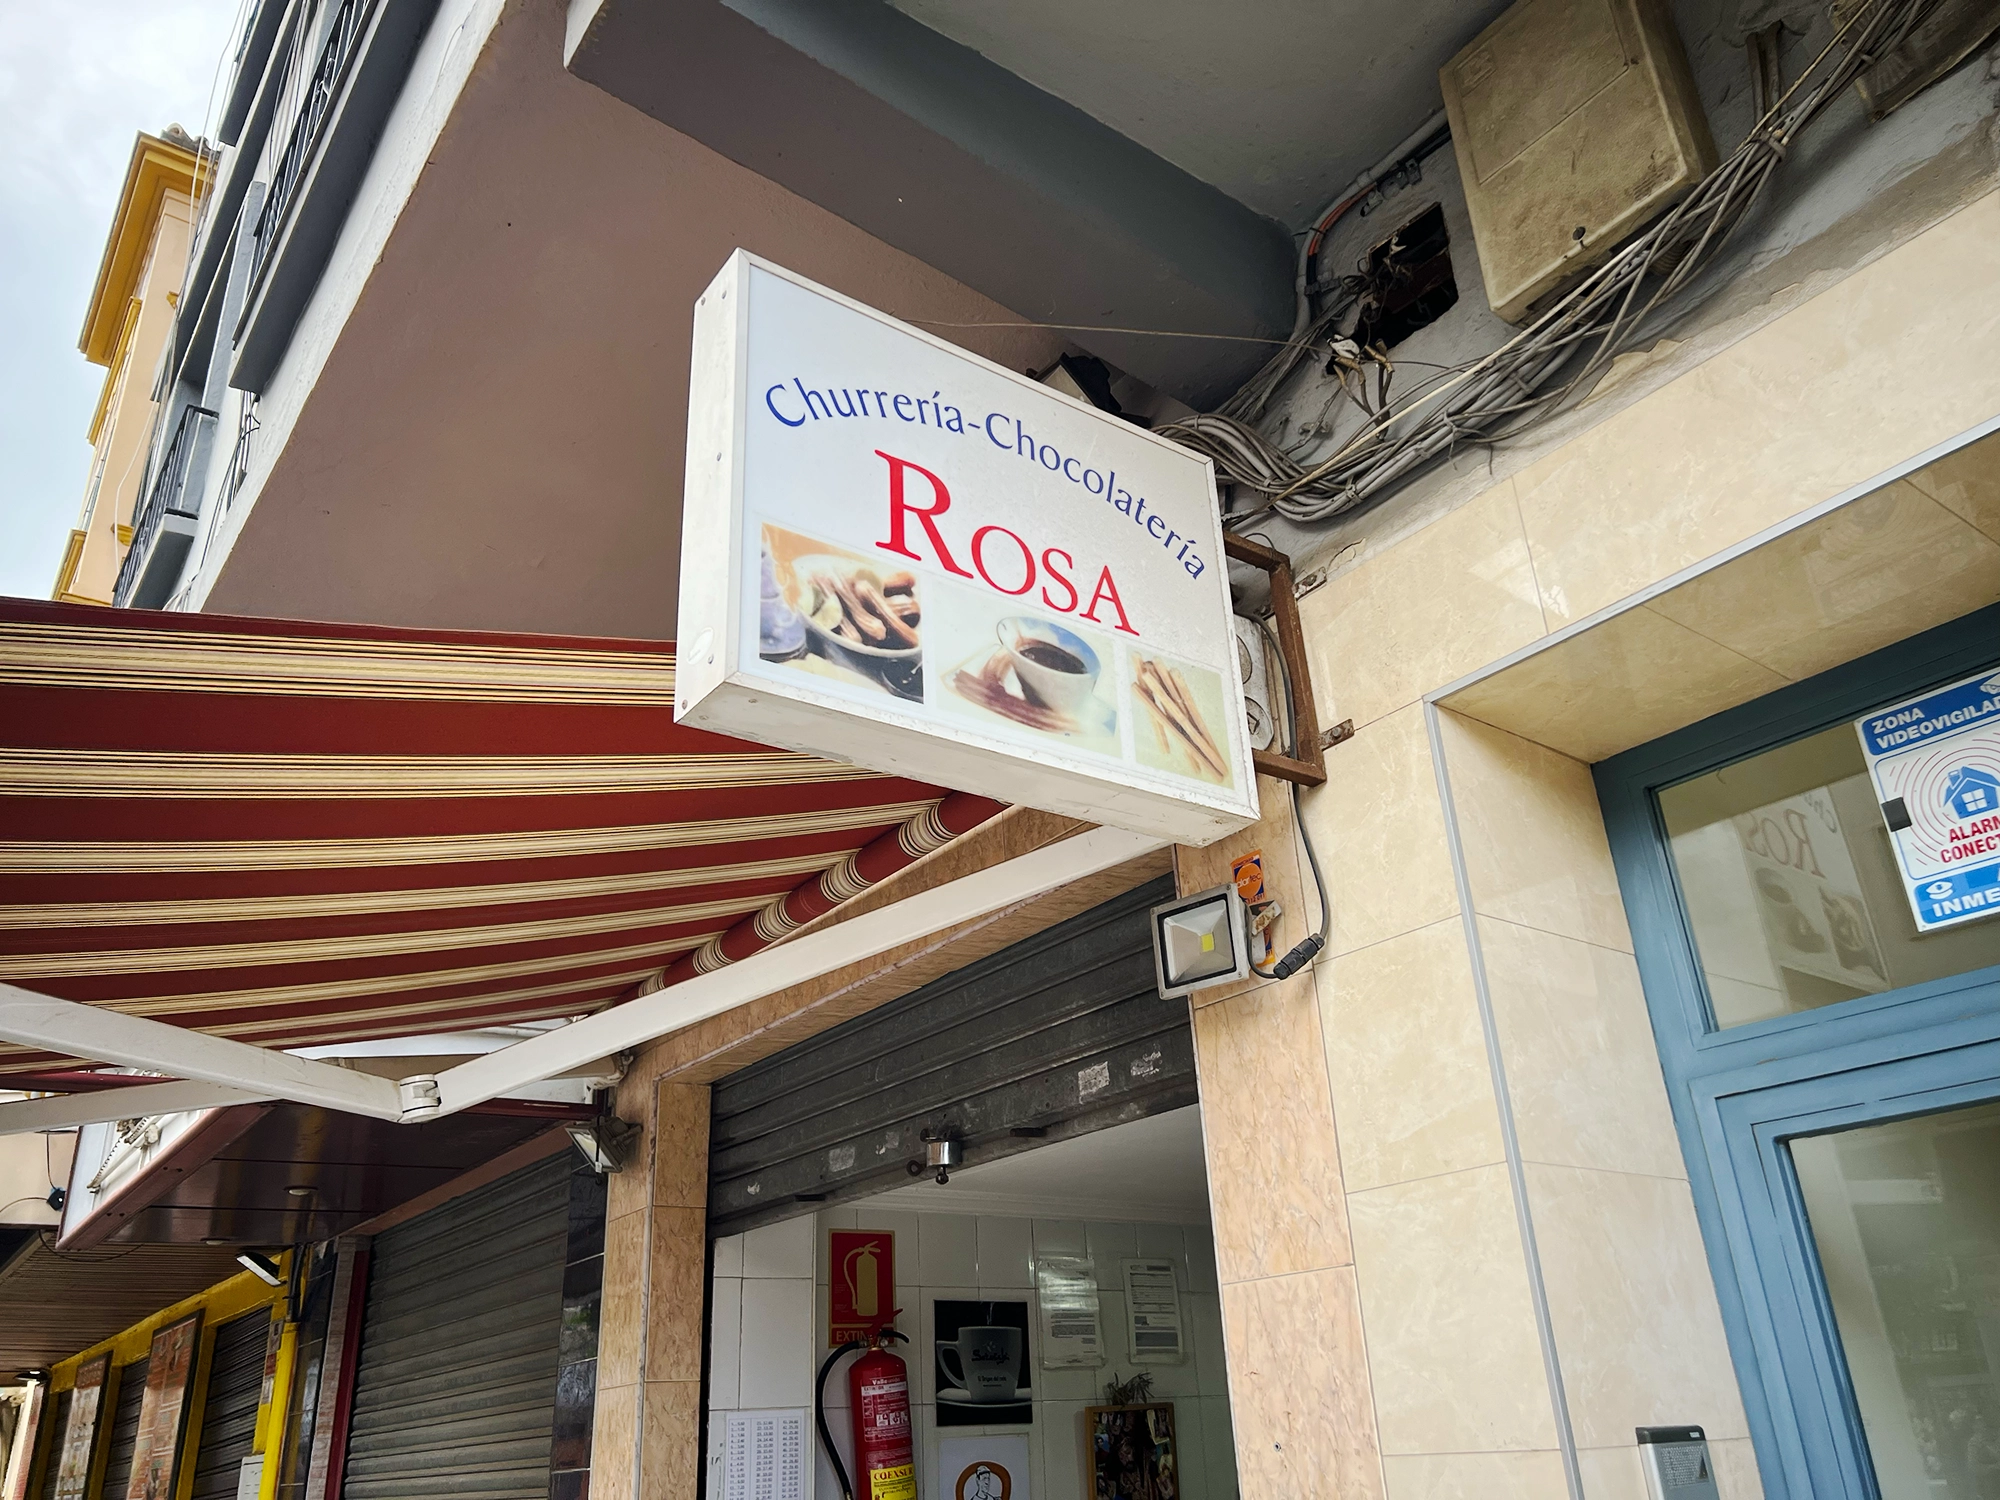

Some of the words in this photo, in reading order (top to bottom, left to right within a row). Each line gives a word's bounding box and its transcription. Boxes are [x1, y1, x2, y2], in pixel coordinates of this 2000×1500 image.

[766, 377, 1205, 579] Churrería-Chocolatería
[874, 449, 1141, 636] ROSA
[1872, 708, 1925, 734] ZONA
